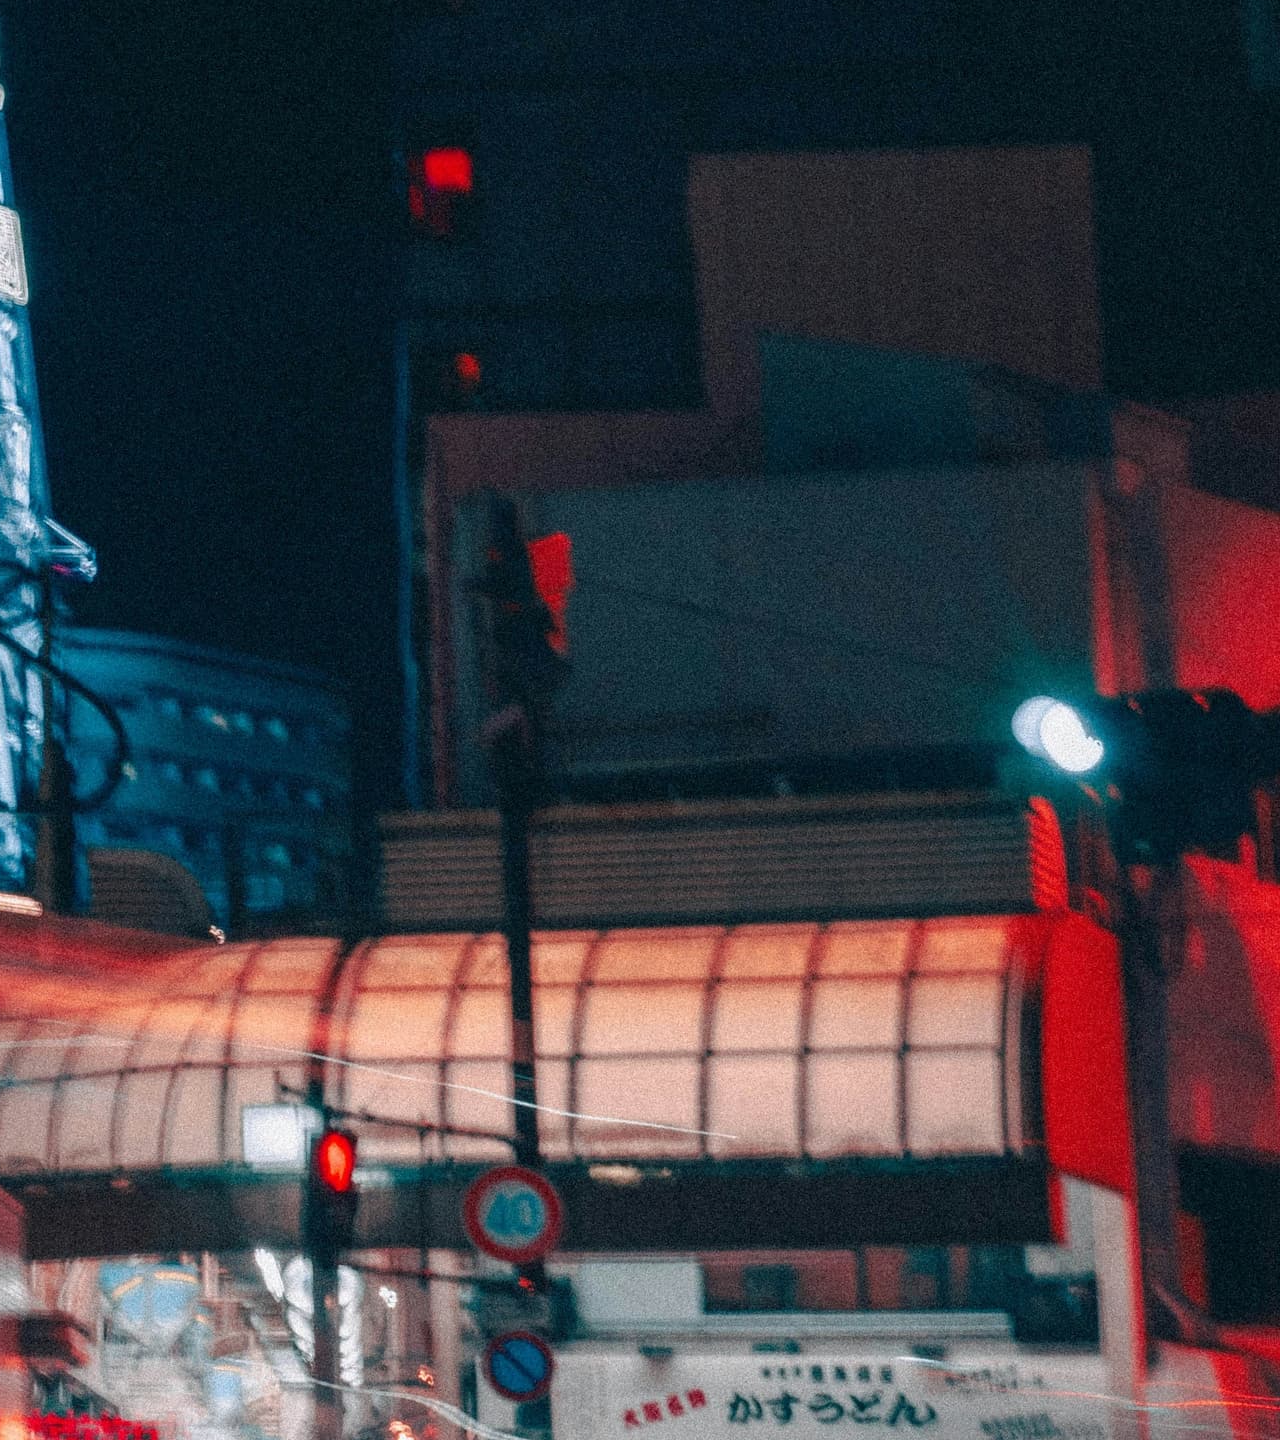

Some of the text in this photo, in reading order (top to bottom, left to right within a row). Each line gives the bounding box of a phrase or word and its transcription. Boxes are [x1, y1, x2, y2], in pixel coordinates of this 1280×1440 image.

[728, 1391, 938, 1428] かすうどん
